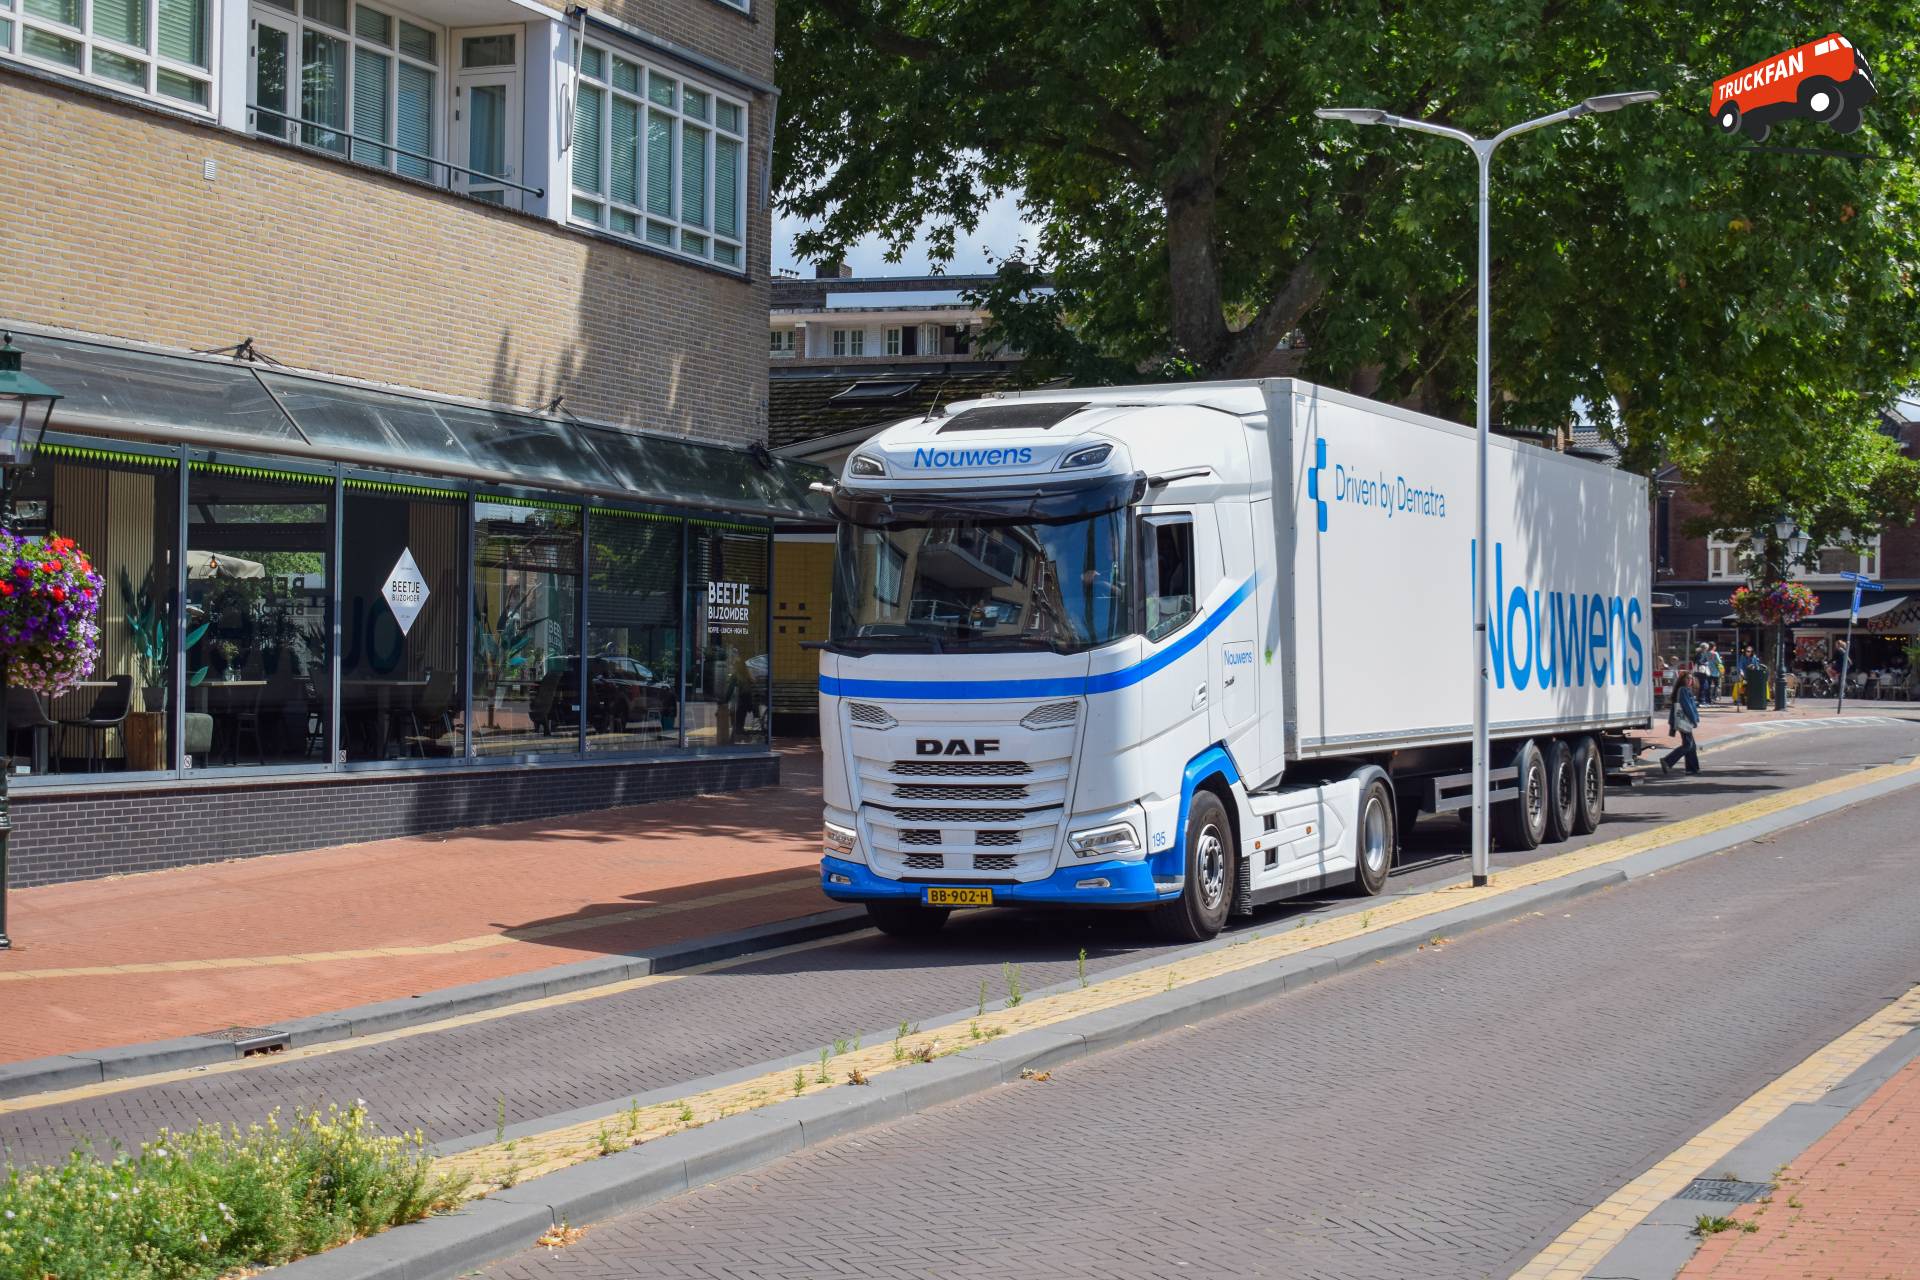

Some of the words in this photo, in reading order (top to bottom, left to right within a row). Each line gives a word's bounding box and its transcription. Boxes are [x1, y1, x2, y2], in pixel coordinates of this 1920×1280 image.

[914, 447, 1032, 468] Nouwens
[1335, 463, 1377, 507] Driven
[1379, 471, 1395, 518] by
[1397, 476, 1446, 518] Dematra
[392, 580, 420, 593] BEETJE
[708, 581, 750, 605] BEETJE
[708, 606, 749, 621] BIJZONDER
[1471, 539, 1644, 691] Nouwens
[1224, 650, 1253, 665] Nouwens
[916, 739, 1000, 755] DAF
[1152, 831, 1166, 848] 195
[931, 890, 989, 903] BB-902-H
